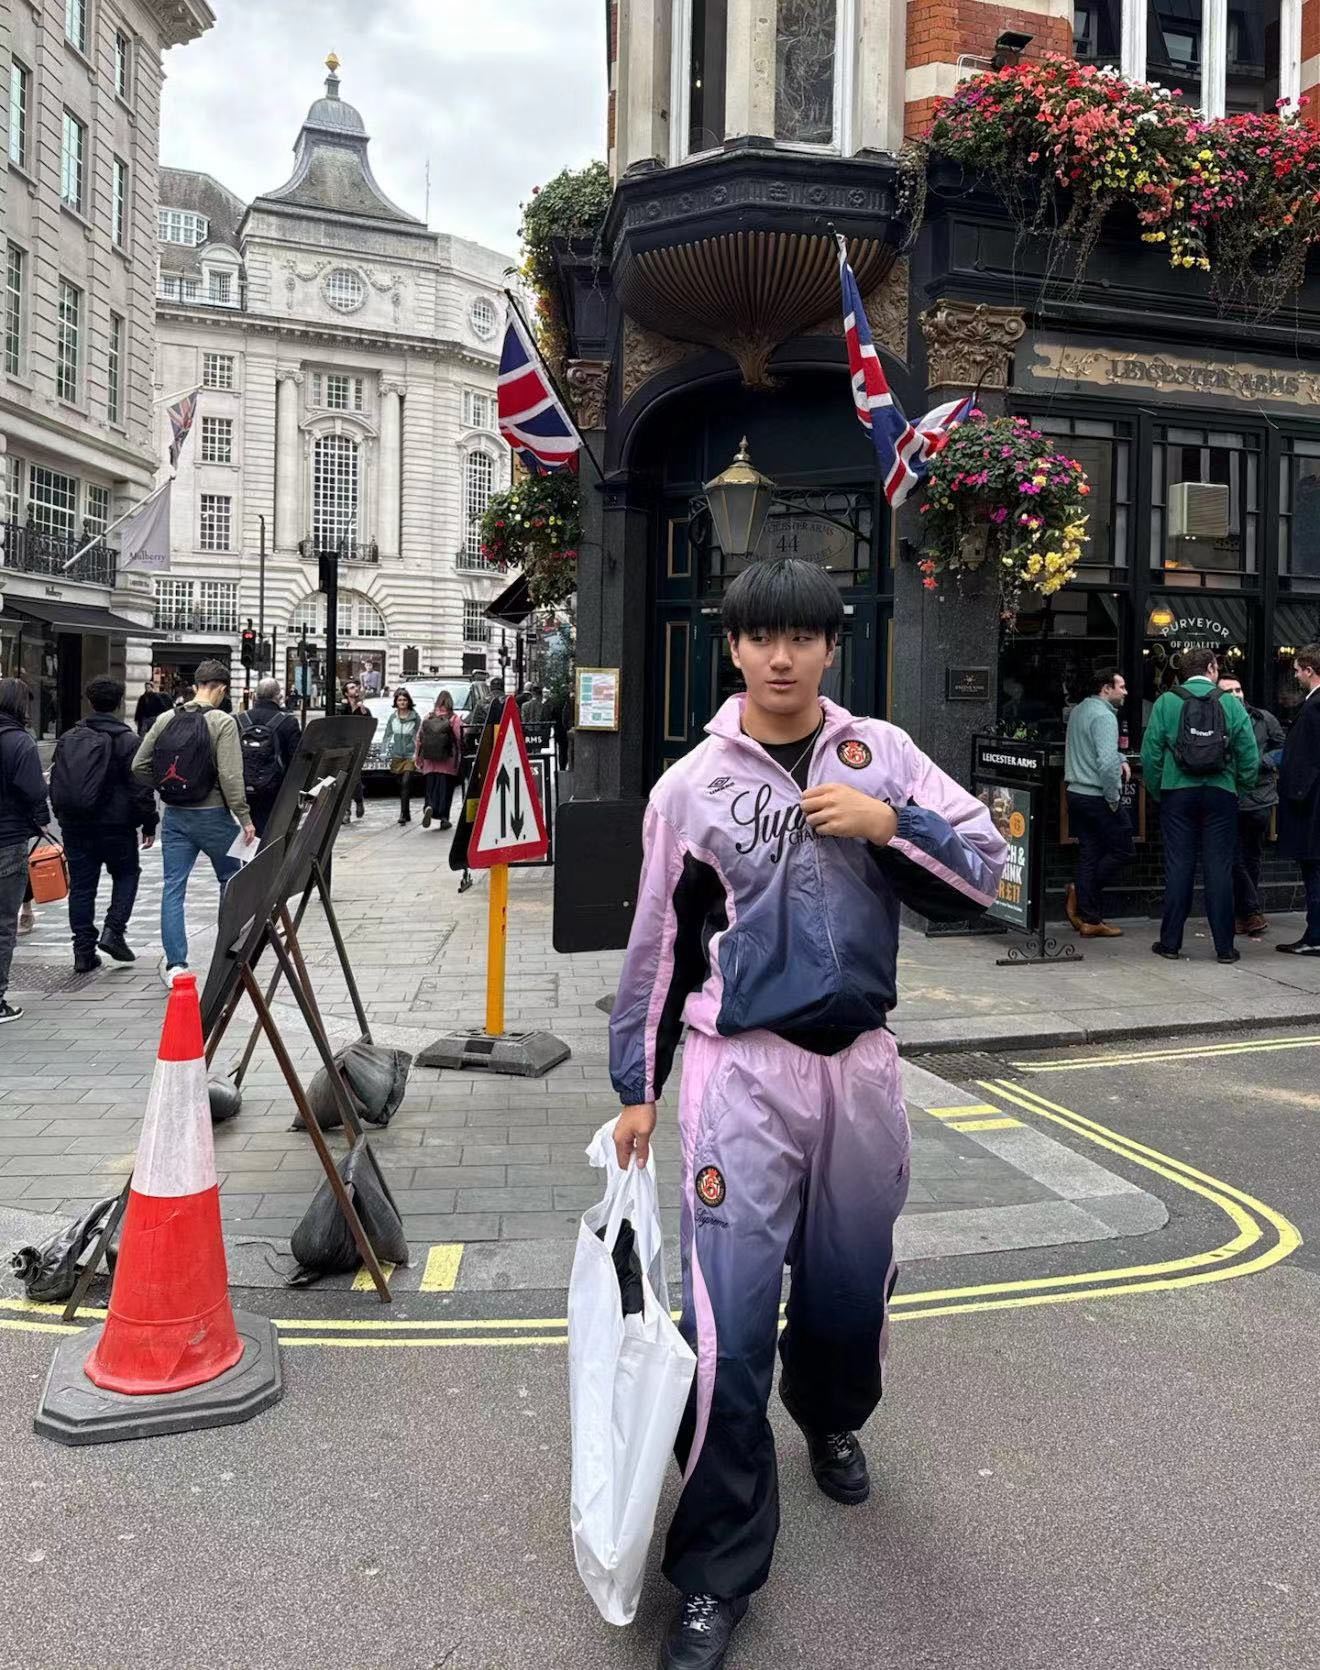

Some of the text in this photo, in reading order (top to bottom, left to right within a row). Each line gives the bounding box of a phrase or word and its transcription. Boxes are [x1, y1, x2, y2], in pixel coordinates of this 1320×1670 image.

[776, 535, 798, 552] 44
[1161, 617, 1230, 638] PURVEYOR
[1170, 641, 1220, 650] OF QUALITY
[524, 735, 542, 744] RMS
[982, 752, 1037, 769] LEICESTER ARMS
